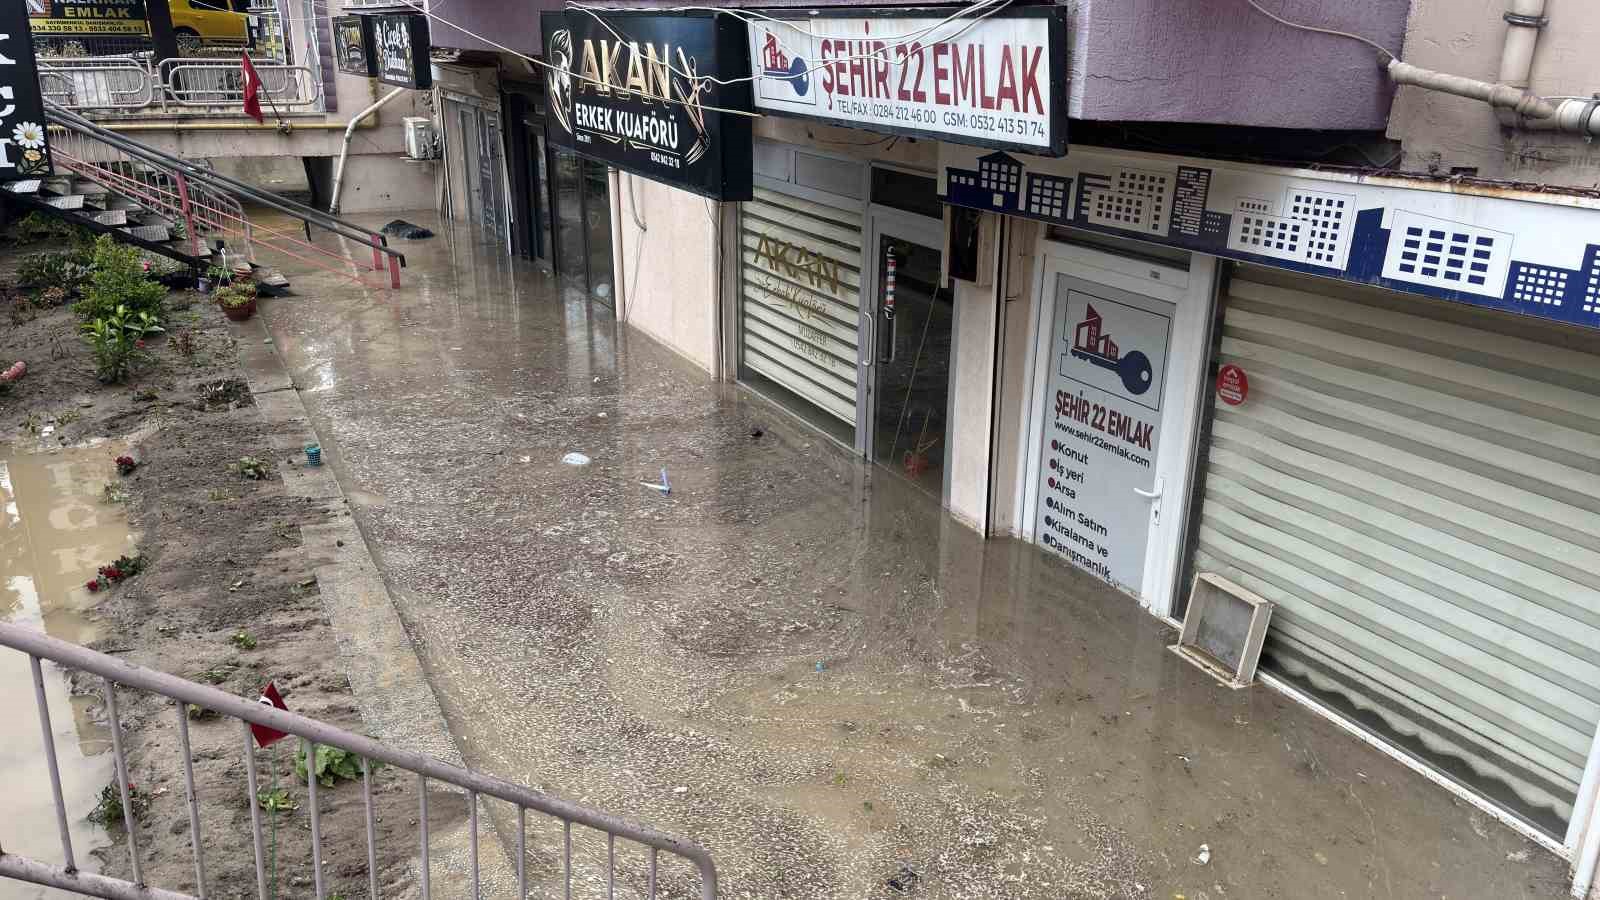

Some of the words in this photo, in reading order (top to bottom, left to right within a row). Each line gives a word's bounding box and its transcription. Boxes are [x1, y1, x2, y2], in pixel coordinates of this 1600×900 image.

[64, 6, 130, 18] EMLAK
[579, 39, 672, 105] AKAN
[820, 20, 890, 110] ŞEHİR
[895, 41, 927, 104] 22
[933, 42, 1045, 115] EMLAK
[575, 103, 613, 132] ERKEK
[616, 110, 678, 149] KUAFÖRÜ
[873, 103, 894, 119] 0284
[896, 106, 910, 121] 212
[911, 109, 921, 122] 46
[923, 109, 937, 124] 00
[943, 111, 968, 128] GSM:
[970, 114, 995, 131] 0532
[997, 118, 1015, 133] 413
[1017, 119, 1028, 135] 51
[1031, 121, 1045, 137] 74
[752, 233, 839, 294] AKAN
[1055, 389, 1090, 425] ŞEHİR
[1091, 403, 1107, 432] 22
[1107, 409, 1154, 452] EMLAK
[1054, 421, 1150, 469] www.sehir22emlak.com
[1058, 441, 1089, 465] Konut
[1054, 480, 1076, 499] Arsa
[1056, 457, 1064, 477] İş
[1065, 466, 1084, 484] yeri
[1051, 518, 1095, 551] Kiralama
[1097, 544, 1109, 558] ve
[1052, 501, 1076, 521] Alım
[1078, 512, 1108, 536] Satım
[1049, 535, 1111, 580] Danışmanlık
